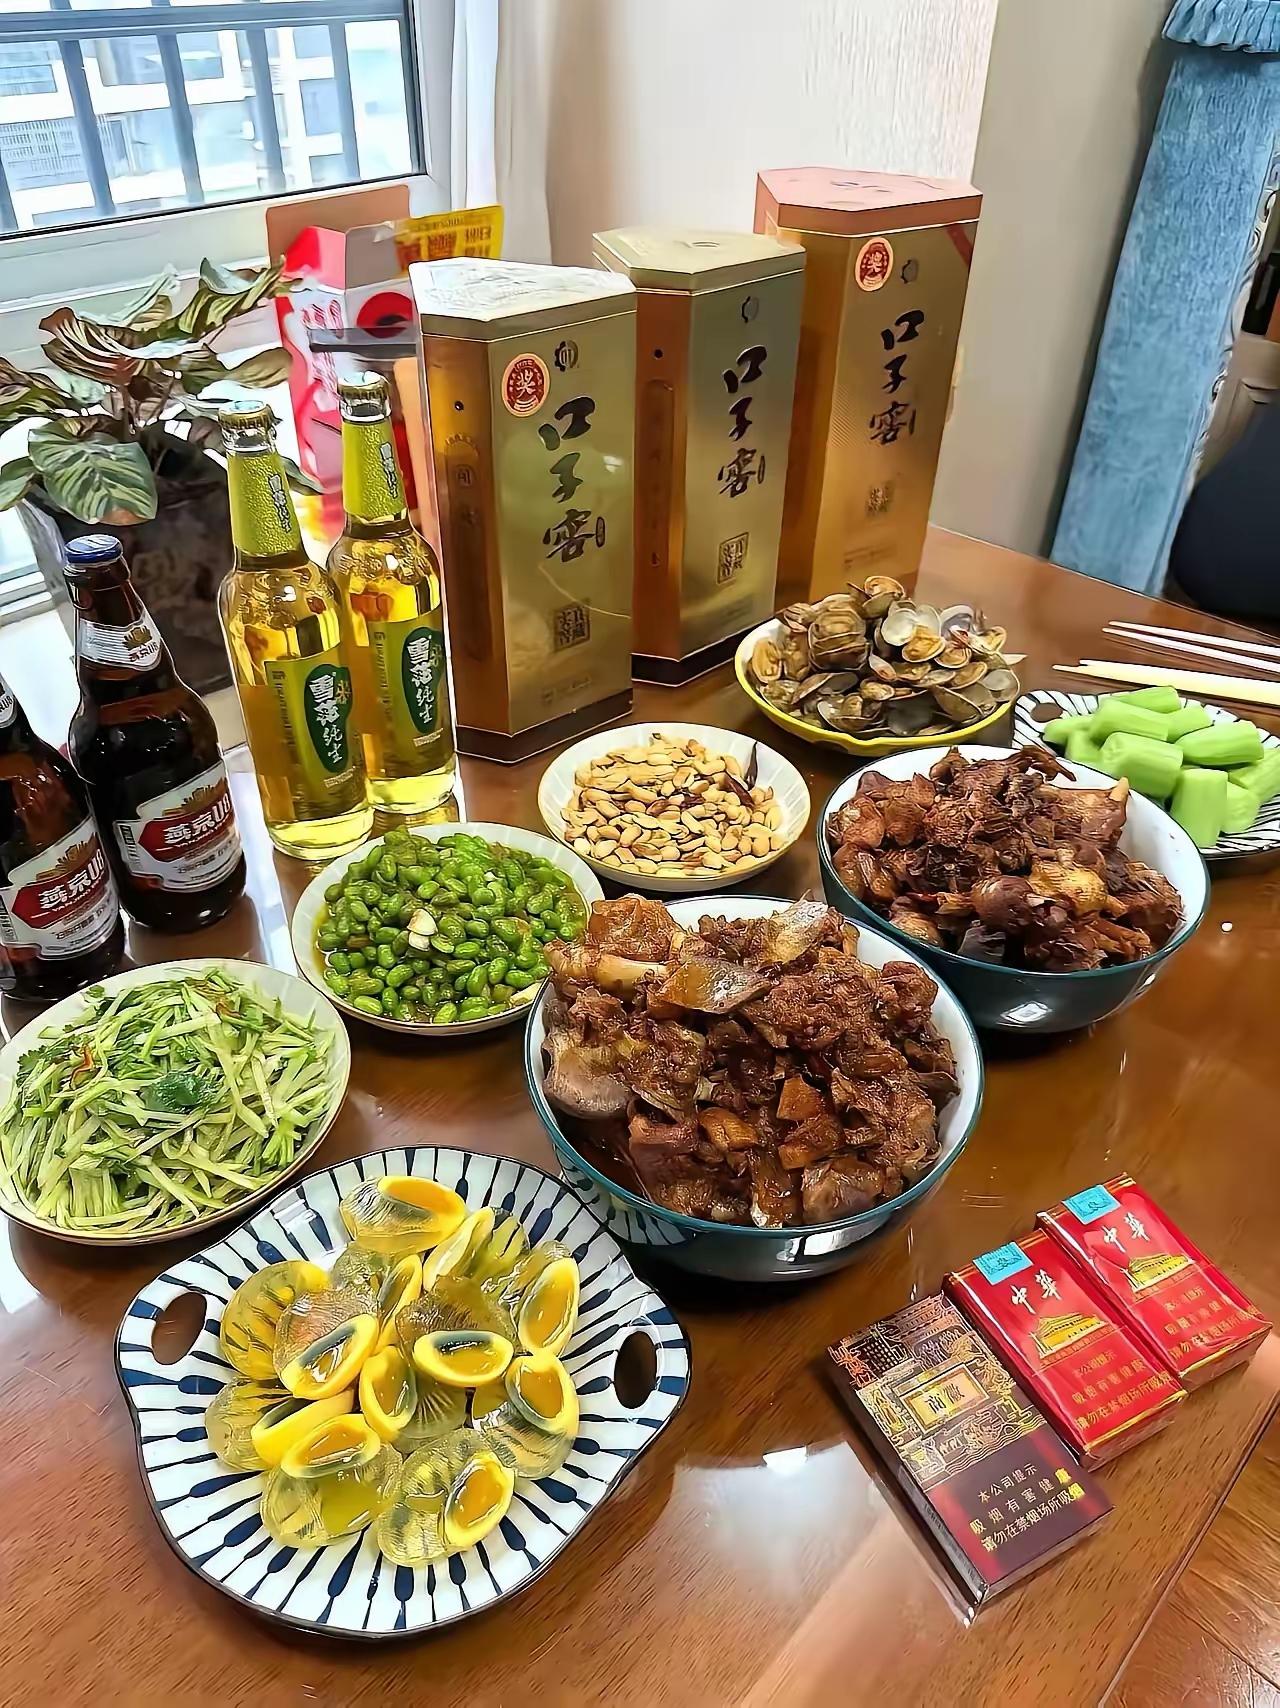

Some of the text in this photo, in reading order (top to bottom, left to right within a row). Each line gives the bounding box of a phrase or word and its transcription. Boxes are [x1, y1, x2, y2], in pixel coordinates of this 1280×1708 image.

[717, 344, 768, 498] 口子窖
[868, 309, 925, 445] 口子窖
[538, 396, 597, 563] 口子窖
[969, 1467, 1072, 1535] 吸烟有害健康
[978, 1463, 1037, 1503] 本公司提示
[981, 1482, 1086, 1552] 请勿在禁烟场所吸烟
